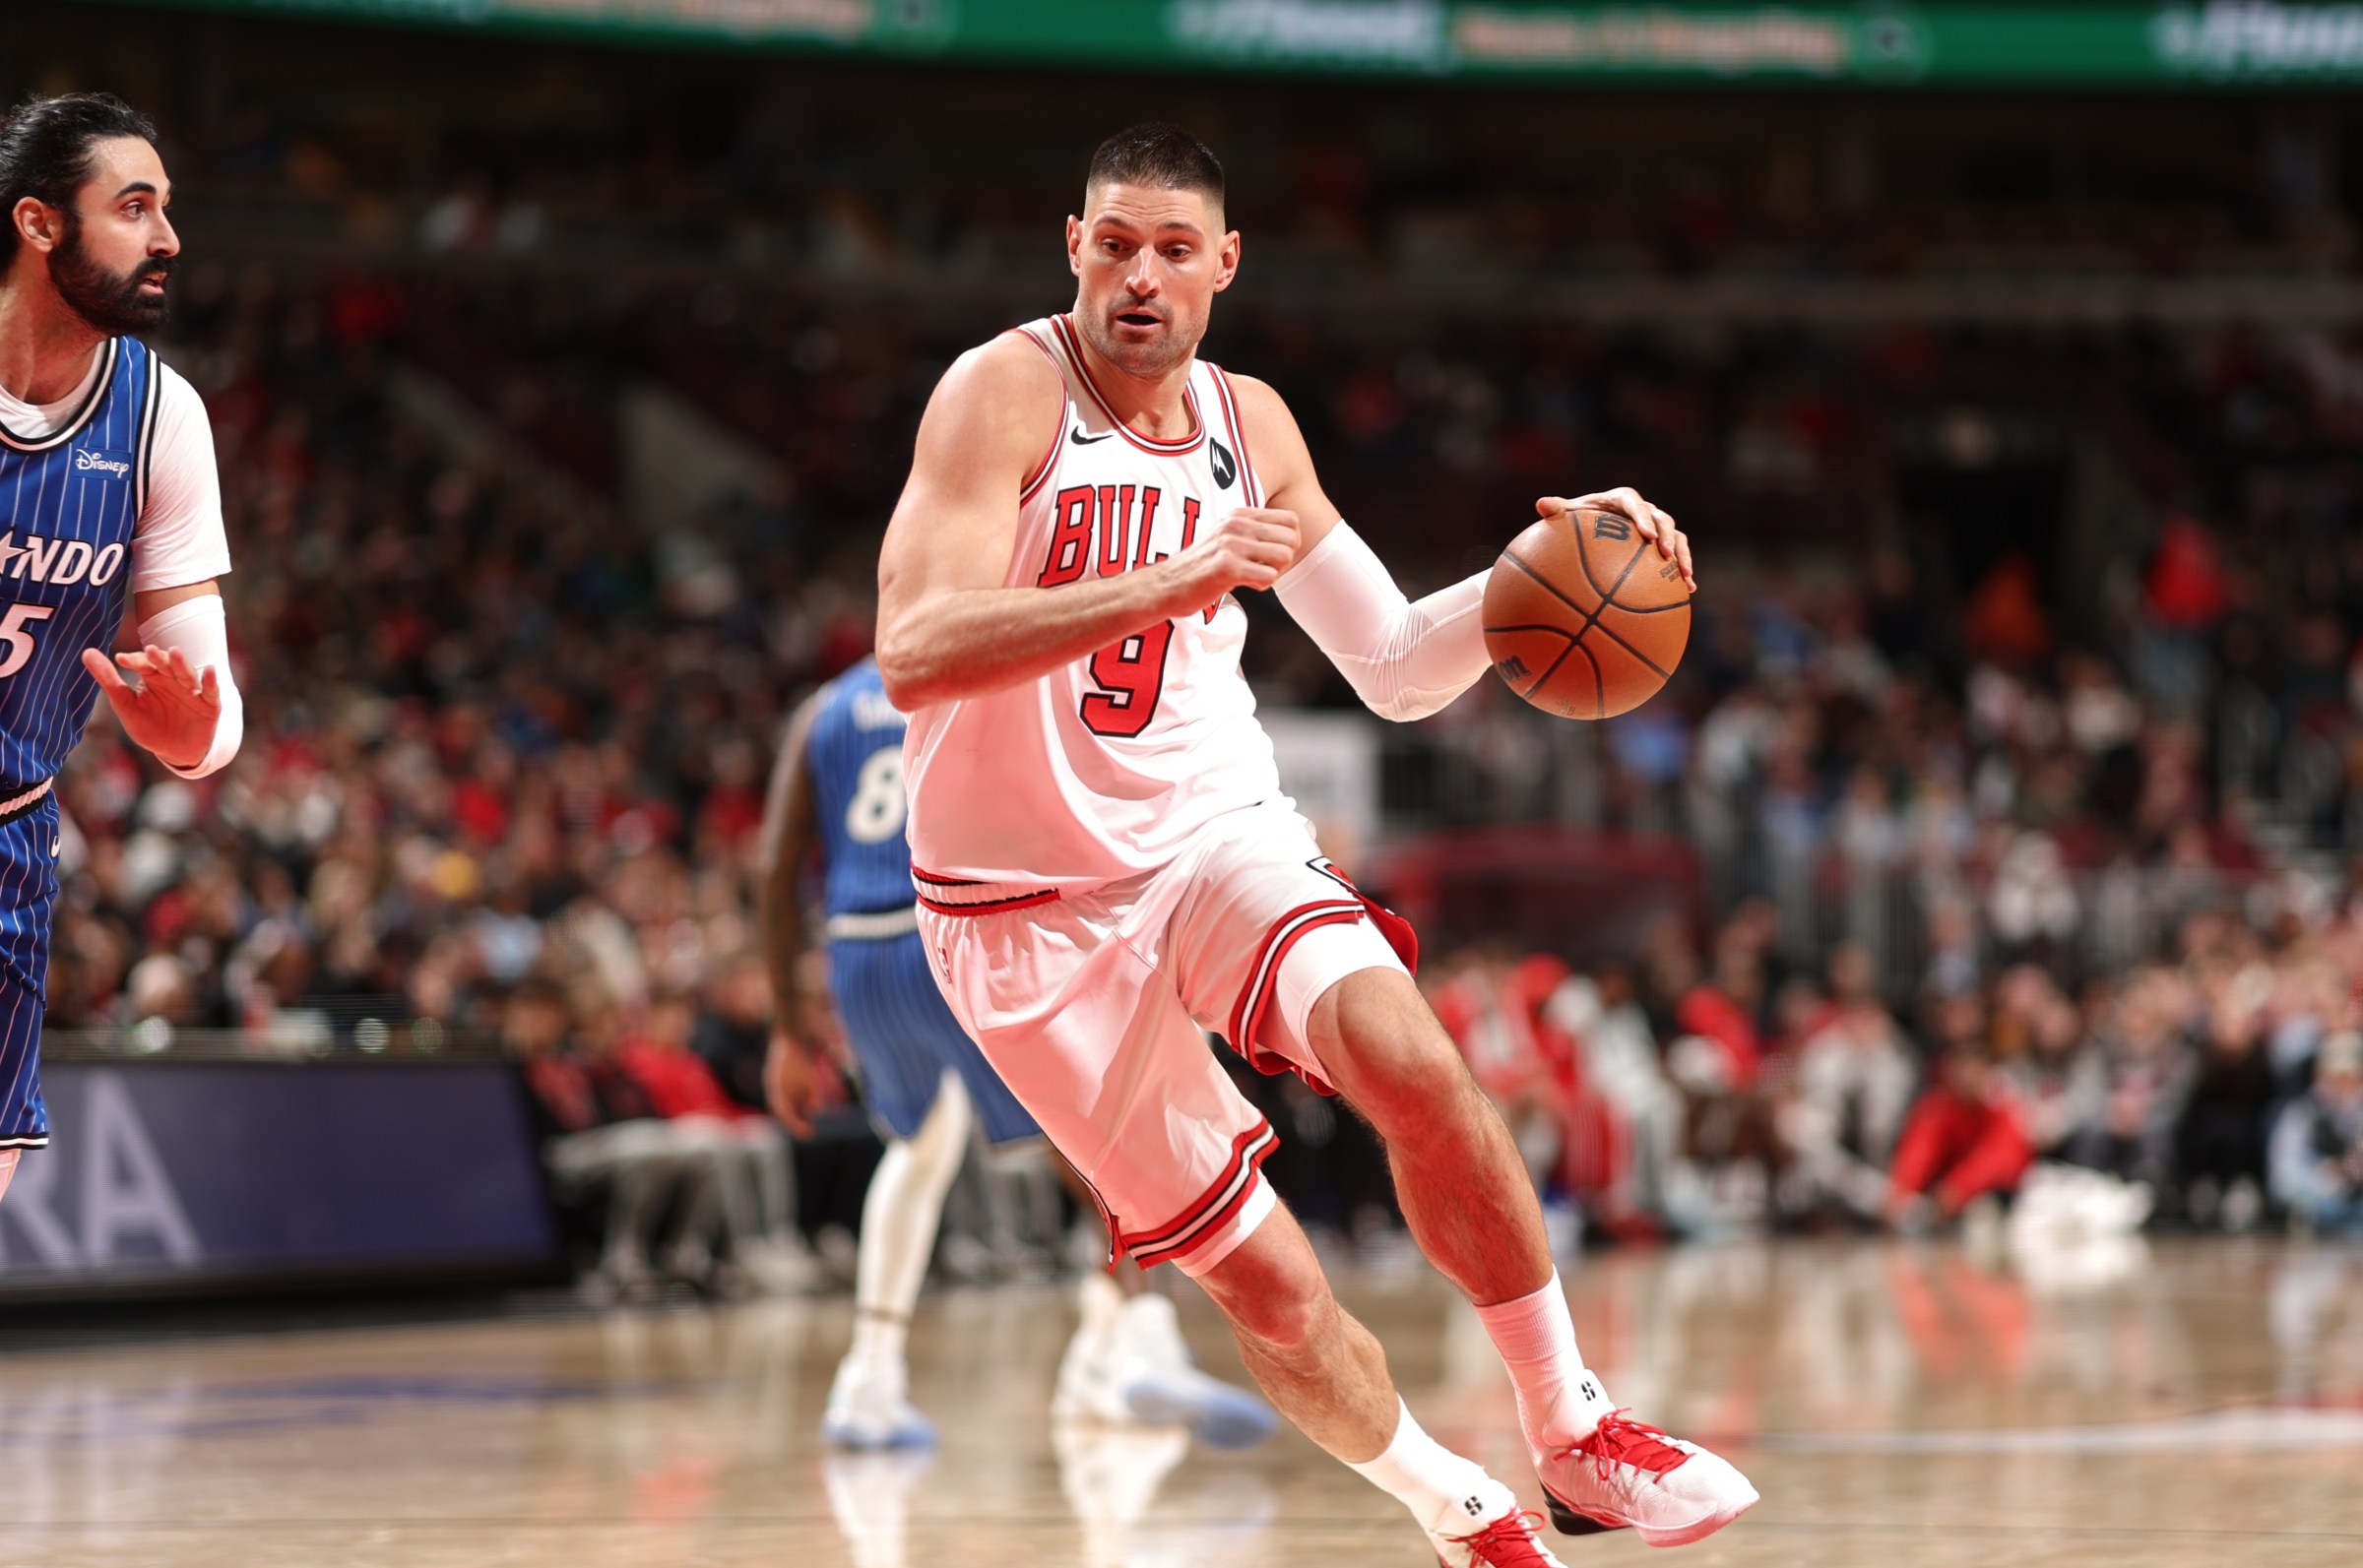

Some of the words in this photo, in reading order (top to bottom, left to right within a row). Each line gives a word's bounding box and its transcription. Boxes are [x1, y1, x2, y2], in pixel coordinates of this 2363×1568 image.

[1038, 484, 1223, 625] BUL
[0, 602, 54, 677] 5
[1079, 618, 1175, 739] 9
